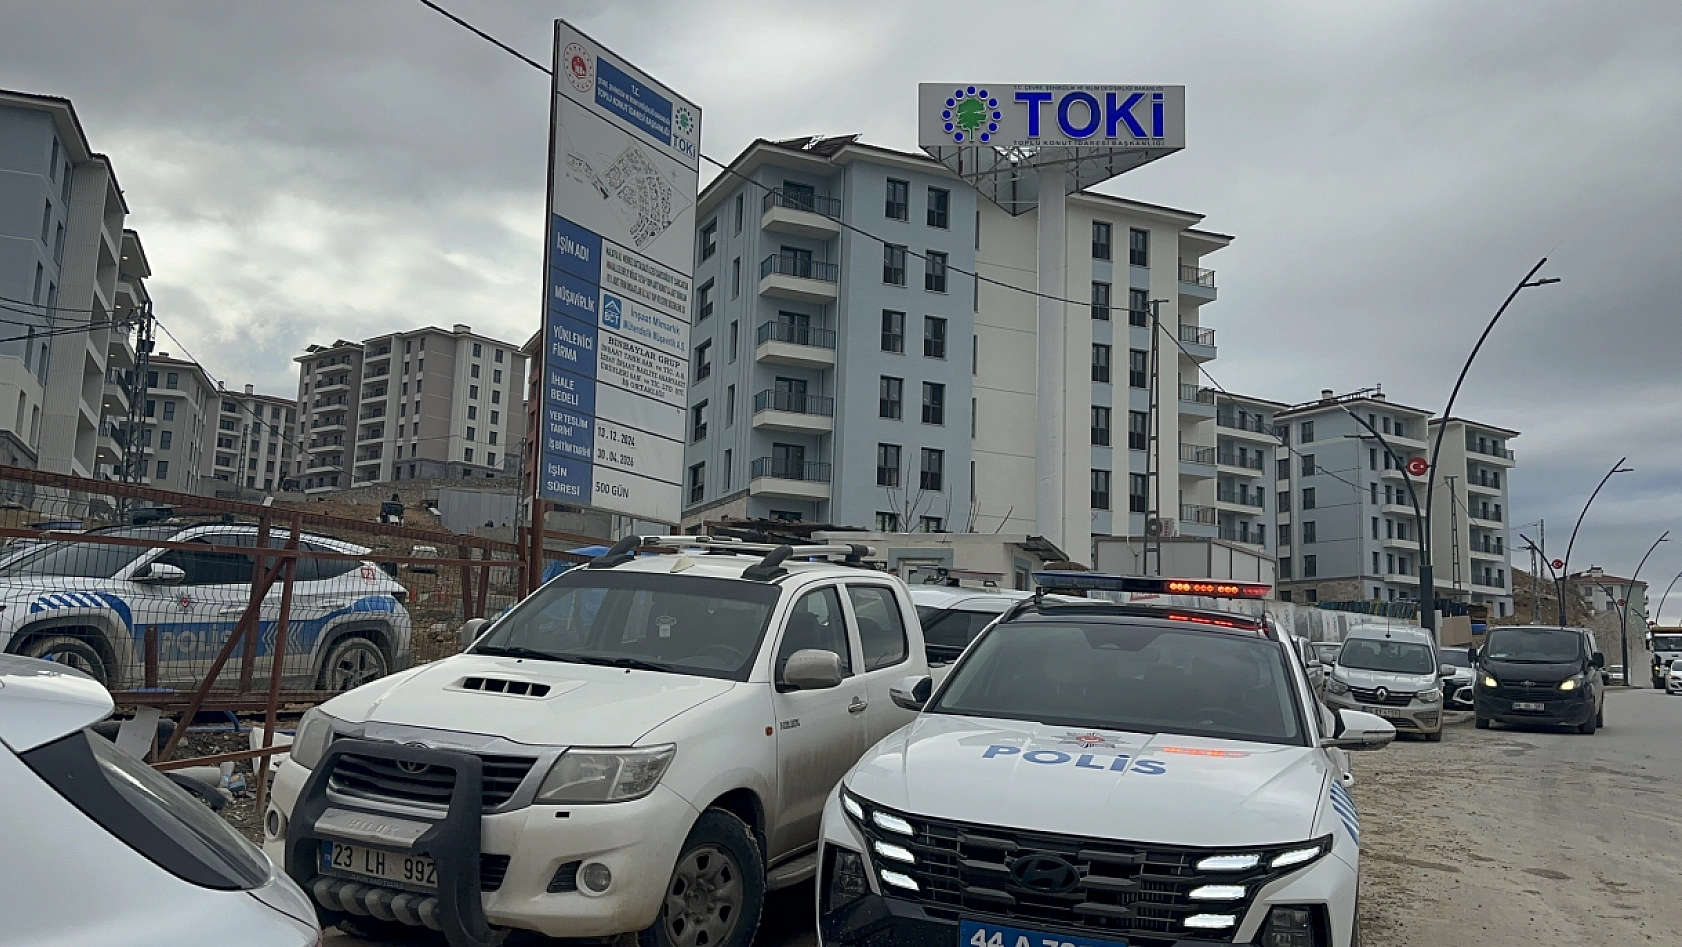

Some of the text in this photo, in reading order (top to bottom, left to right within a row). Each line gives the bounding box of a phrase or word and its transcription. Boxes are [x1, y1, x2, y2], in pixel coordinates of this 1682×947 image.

[557, 232, 590, 261] İŞİN ADI
[555, 285, 595, 312] MÜŞAVİRLİK
[553, 325, 594, 351] YÜKLENİCİ
[552, 342, 577, 362] FİRMA
[658, 355, 680, 368] GRUP
[551, 372, 575, 391] İHALE
[550, 388, 579, 406] BEDELİ
[564, 413, 588, 429] TESLİM
[548, 462, 567, 476] İŞİN
[547, 481, 580, 496] SÜRESİ
[596, 481, 630, 498] 500 GÜN
[333, 844, 352, 868] 23
[365, 849, 385, 875] LH
[404, 858, 436, 884] 992
